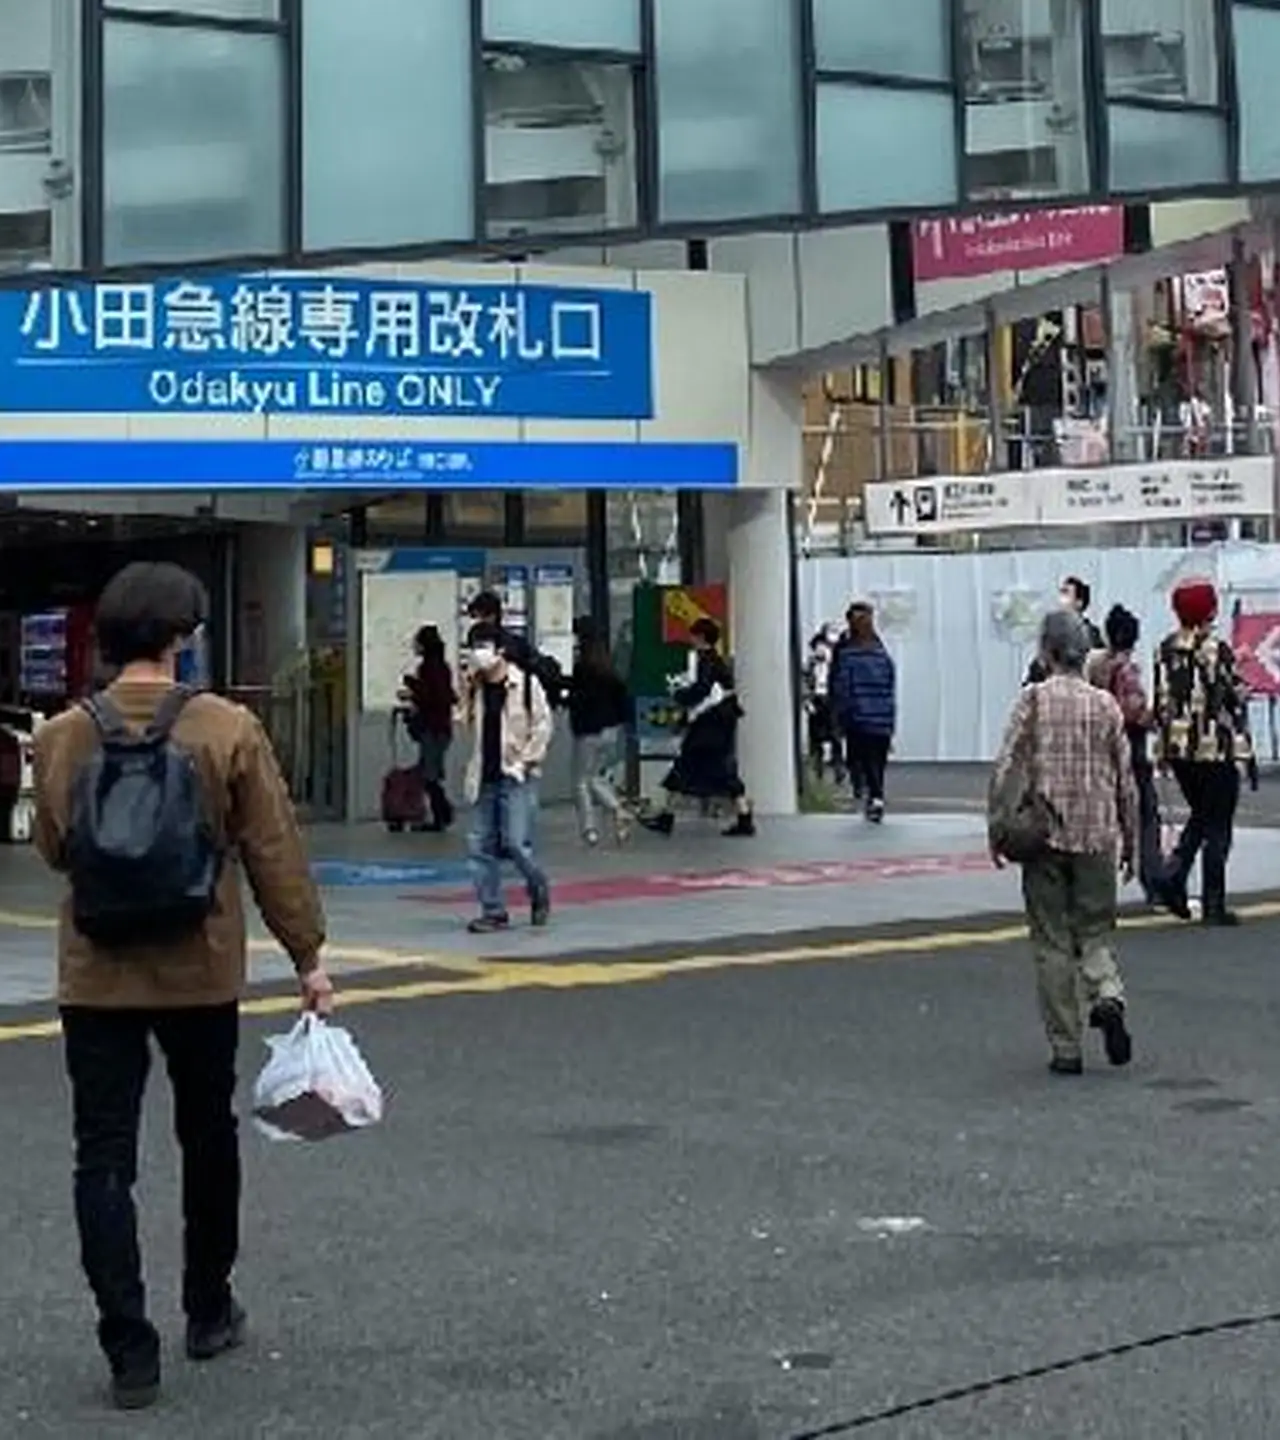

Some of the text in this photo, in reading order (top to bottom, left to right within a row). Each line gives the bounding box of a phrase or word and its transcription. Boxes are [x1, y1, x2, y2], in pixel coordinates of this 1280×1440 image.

[20, 281, 600, 359] 小田急線専用改札口
[149, 370, 502, 412] Odakyu Line ONLY
